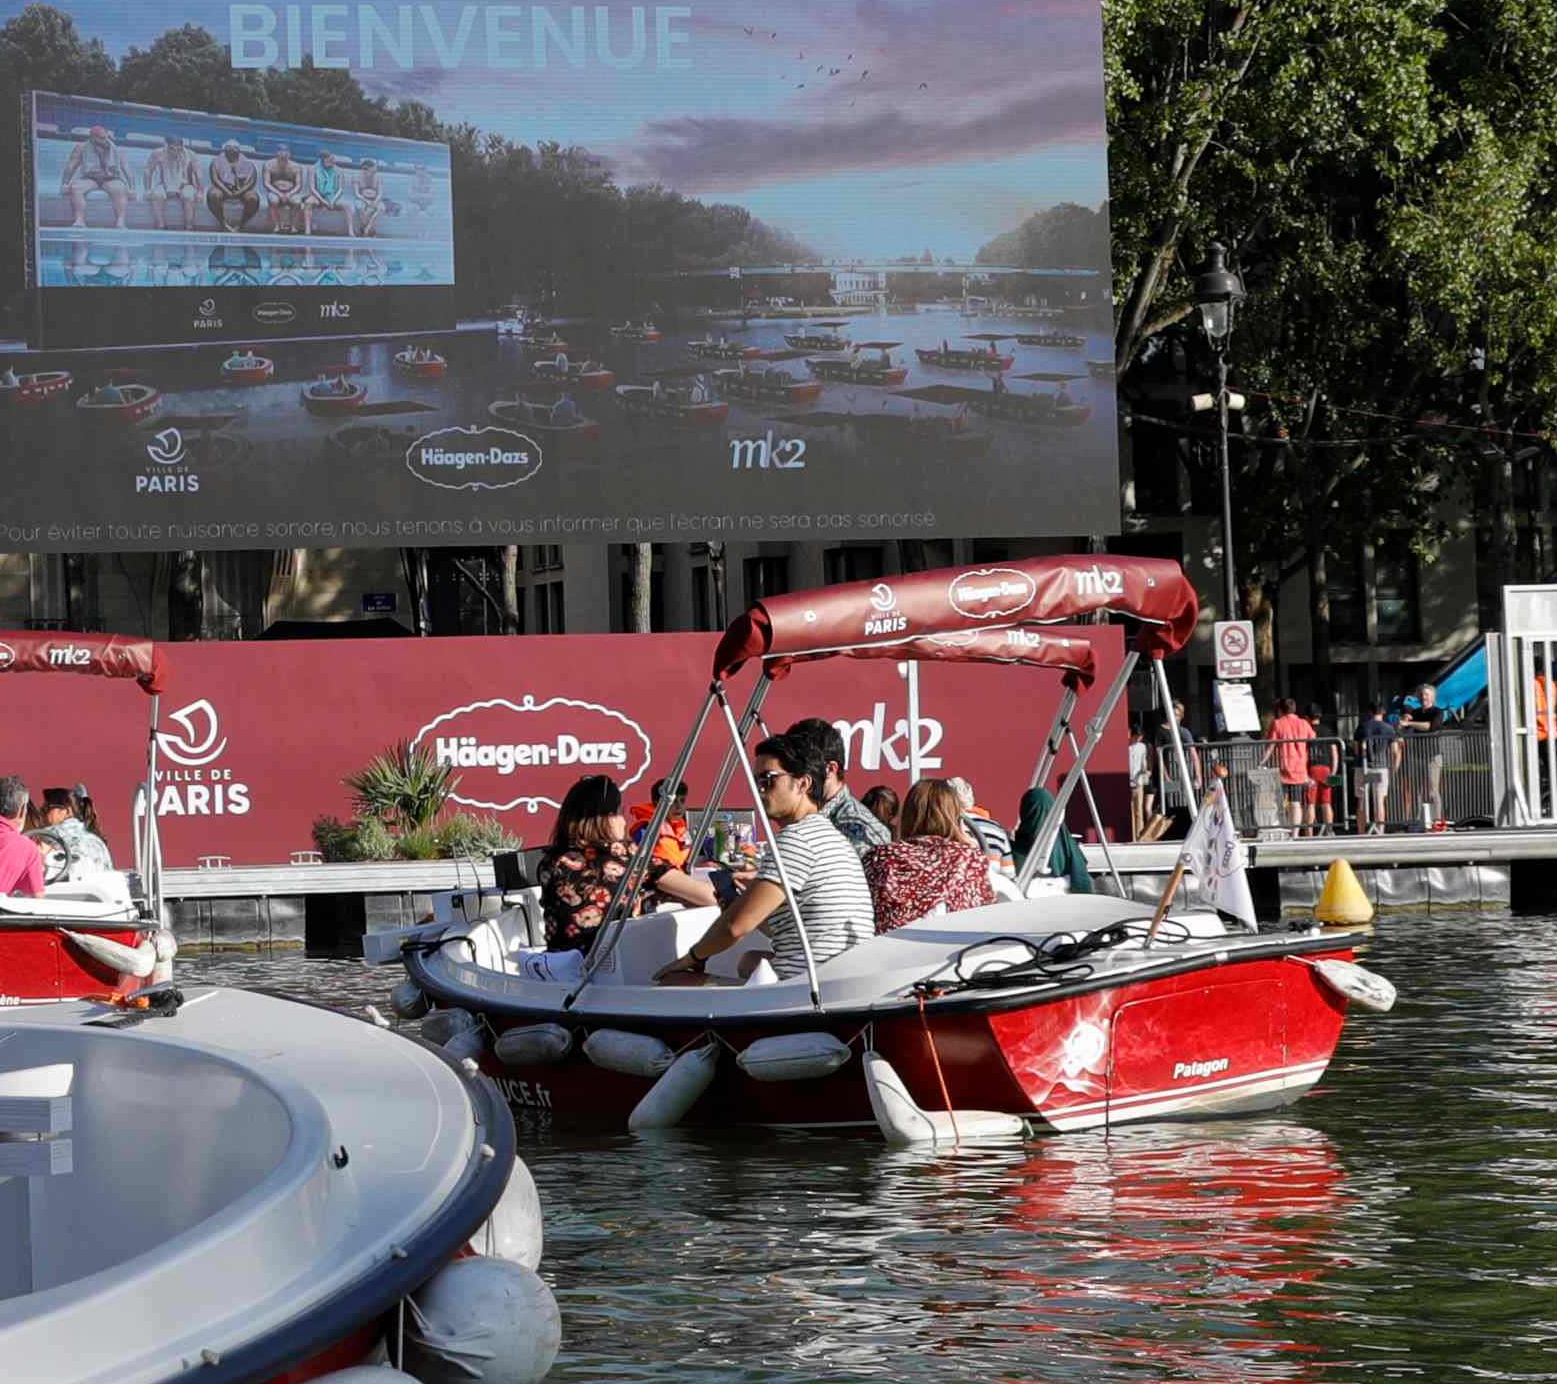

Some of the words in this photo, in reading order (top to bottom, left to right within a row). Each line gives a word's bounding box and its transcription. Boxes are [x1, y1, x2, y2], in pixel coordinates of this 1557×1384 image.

[230, 3, 694, 71] BIENVENUE
[420, 447, 529, 470] Häagen-Dazs
[729, 429, 806, 469] mk2
[135, 474, 200, 493] PARIS
[47, 521, 104, 540] éviter
[107, 522, 161, 539] toute
[168, 520, 258, 539] nuisance
[341, 520, 391, 537] nous
[395, 519, 464, 536] tenons
[487, 519, 535, 535] vous
[538, 515, 623, 534] informer
[1074, 565, 1124, 595] mk2
[864, 616, 907, 635] PARIS
[49, 648, 90, 665] mk2
[832, 702, 943, 771] mk2
[435, 734, 627, 775] Häagen-Dazs
[154, 769, 202, 781] VILLE
[211, 769, 232, 780] DE
[1173, 1058, 1229, 1079] Patagon
